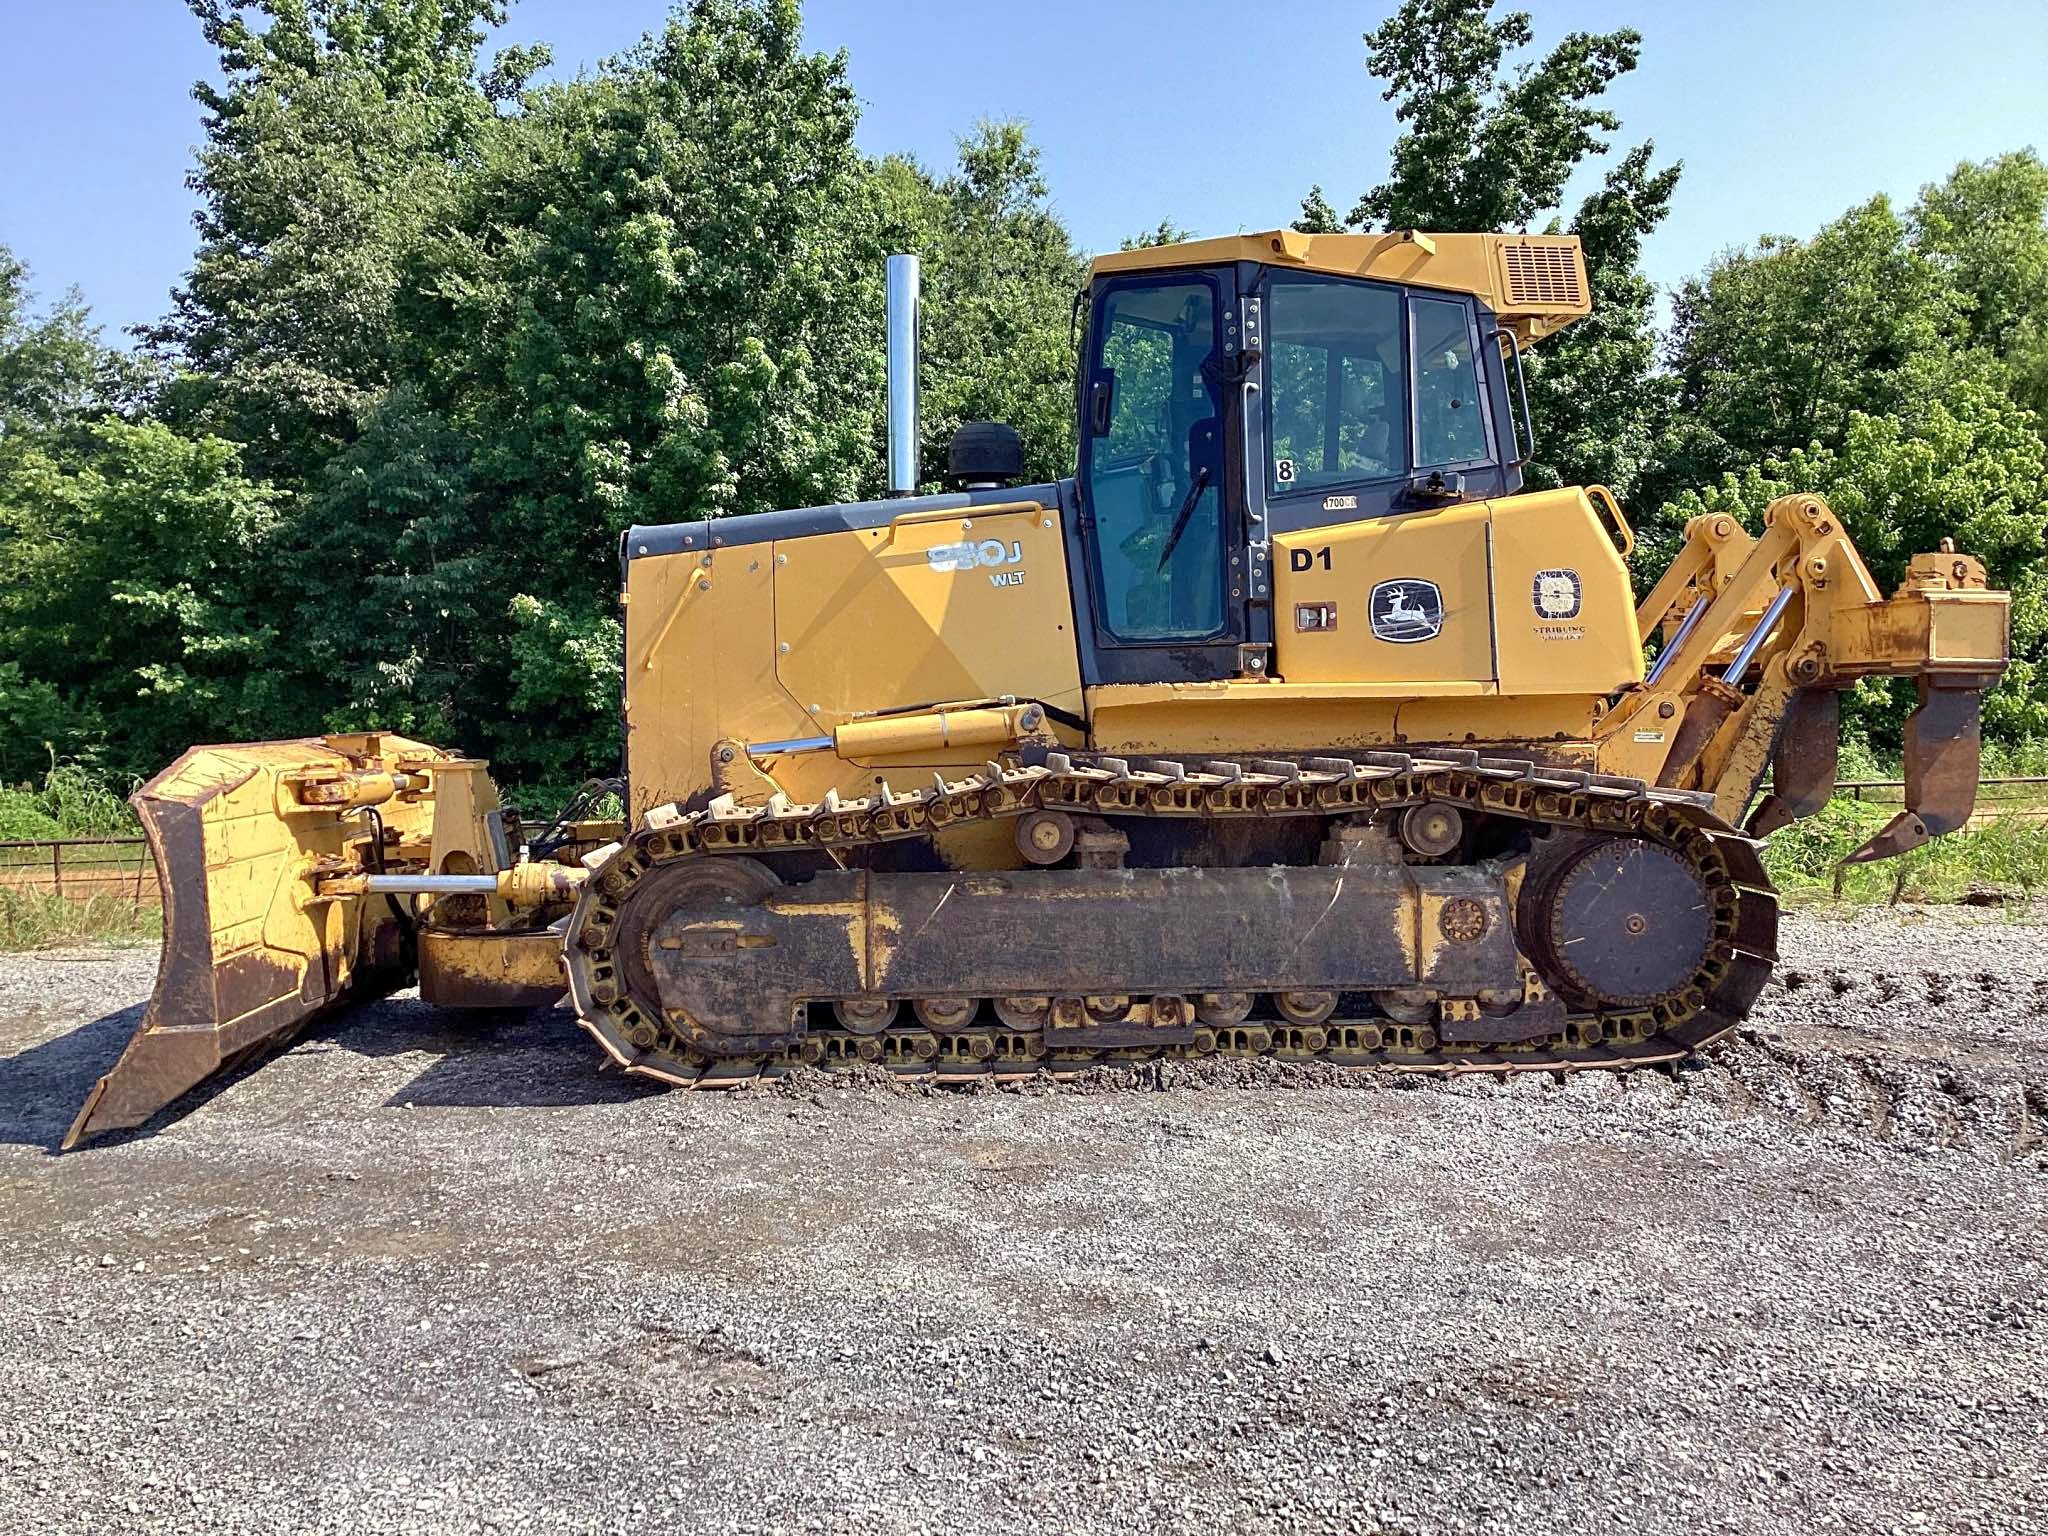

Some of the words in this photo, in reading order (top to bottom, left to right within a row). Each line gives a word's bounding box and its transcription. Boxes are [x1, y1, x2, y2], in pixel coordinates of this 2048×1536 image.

[1278, 461, 1293, 481] 8
[1290, 546, 1332, 572] D1
[988, 571, 1026, 588] WLT
